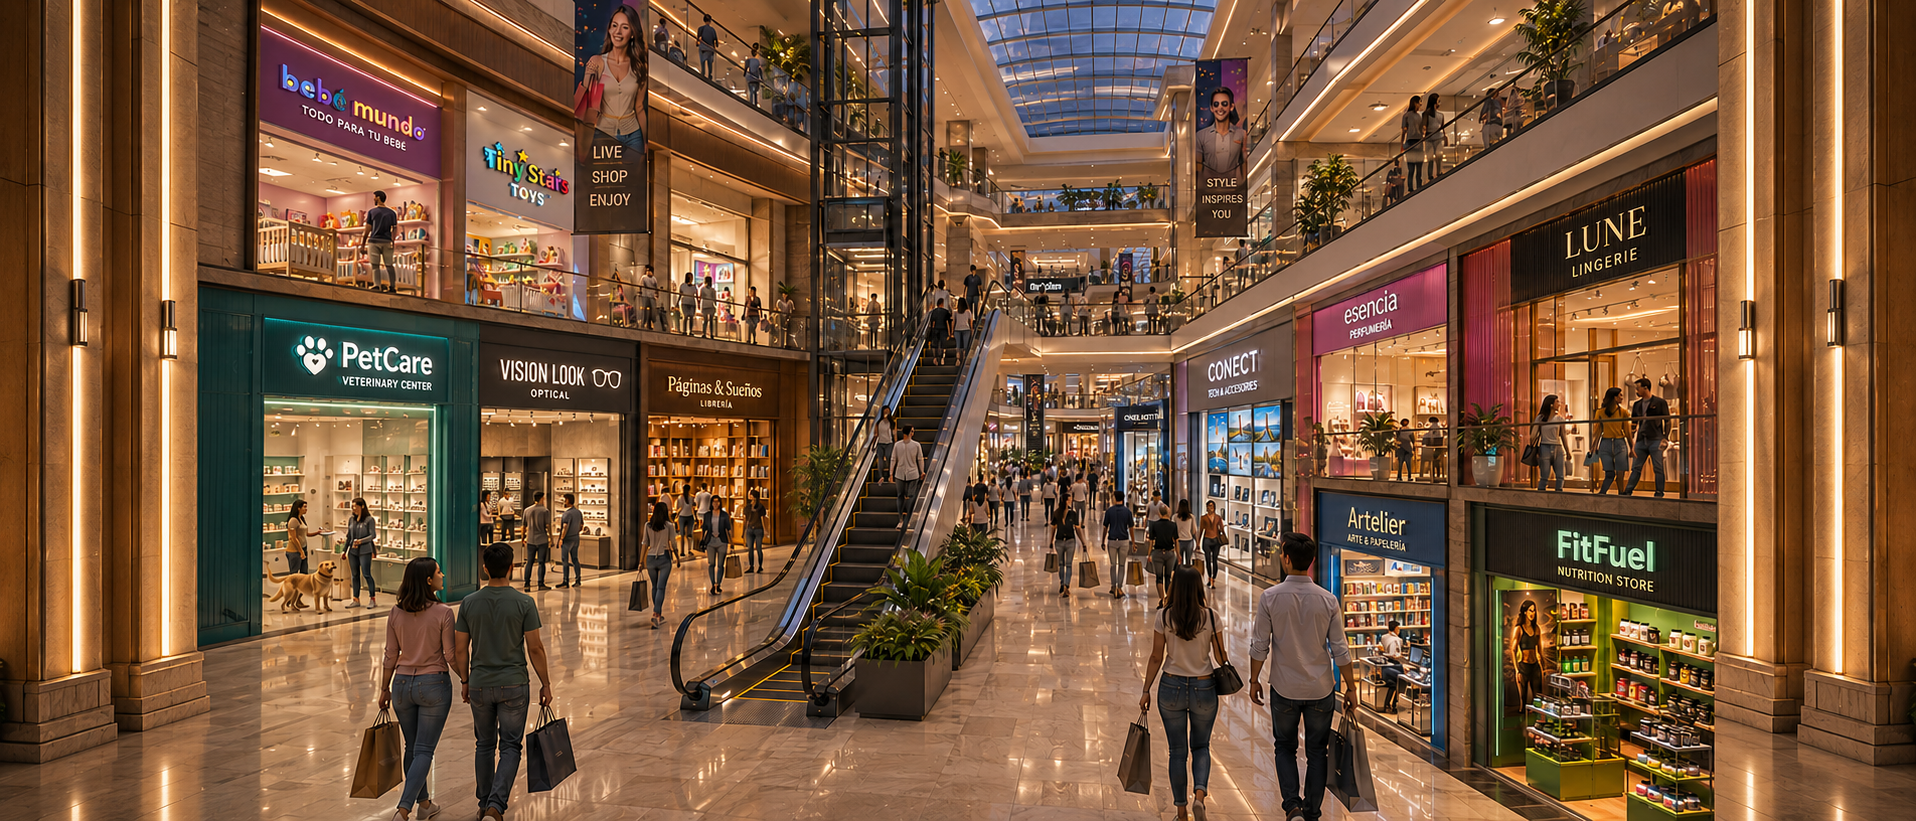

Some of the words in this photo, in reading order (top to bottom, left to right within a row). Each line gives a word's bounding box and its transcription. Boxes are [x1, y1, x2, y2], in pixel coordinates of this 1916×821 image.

[279, 63, 347, 111] bebé
[353, 100, 425, 140] mundo
[302, 105, 334, 124] TODO
[338, 119, 365, 136] PARA
[368, 129, 381, 142] TU
[384, 135, 407, 151] BEBÉ
[593, 145, 623, 159] LIVE
[483, 144, 525, 183] Tiny
[527, 163, 569, 195] Stars
[592, 170, 628, 183] SHOP
[1206, 177, 1237, 188] STYLE
[509, 182, 545, 206] TOYS
[589, 193, 631, 207] ENJOY
[1201, 194, 1244, 204] INSPIRES
[1211, 209, 1232, 219] YOU
[1564, 205, 1647, 260] LUNE
[1572, 247, 1638, 278] LINGERIE
[1344, 289, 1398, 325] esencia
[341, 341, 433, 376] PetCare
[1207, 349, 1258, 383] CONECT
[341, 375, 399, 389] VETERINARY
[400, 380, 433, 391] CENTER
[499, 359, 548, 383] VISION
[552, 364, 585, 387] LOOK
[530, 388, 570, 400] OPTICAL
[667, 375, 712, 397] Páginas
[714, 379, 725, 396] &
[725, 380, 763, 398] Sueños
[700, 399, 733, 409] LIBRERÍA
[1347, 506, 1406, 536] Artelier
[1347, 533, 1363, 545] ARTE
[1557, 529, 1655, 573] FitFuel
[1557, 565, 1613, 586] NUTRITION
[1616, 575, 1654, 593] STORE
